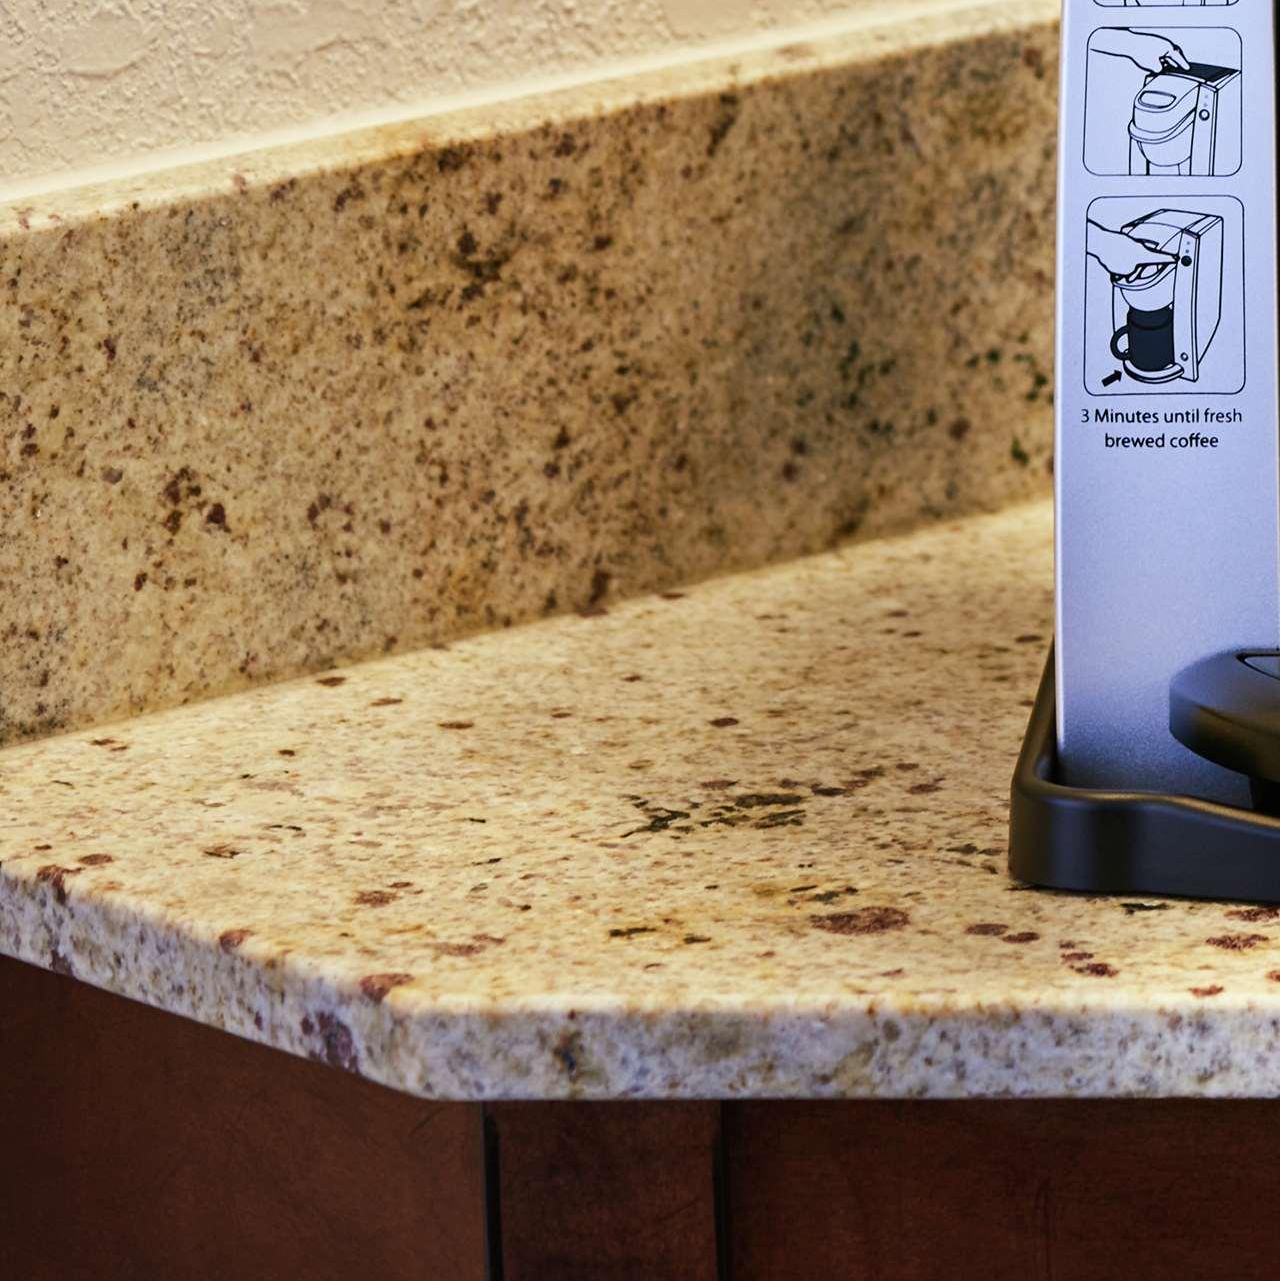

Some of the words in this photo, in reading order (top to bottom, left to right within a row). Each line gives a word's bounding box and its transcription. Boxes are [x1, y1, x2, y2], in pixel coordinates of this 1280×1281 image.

[1081, 408, 1090, 423] 3
[1094, 408, 1160, 423] Minutes
[1164, 408, 1200, 423] until
[1203, 408, 1243, 423] fresh
[1104, 433, 1165, 448] brewed
[1169, 432, 1219, 448] coffee
